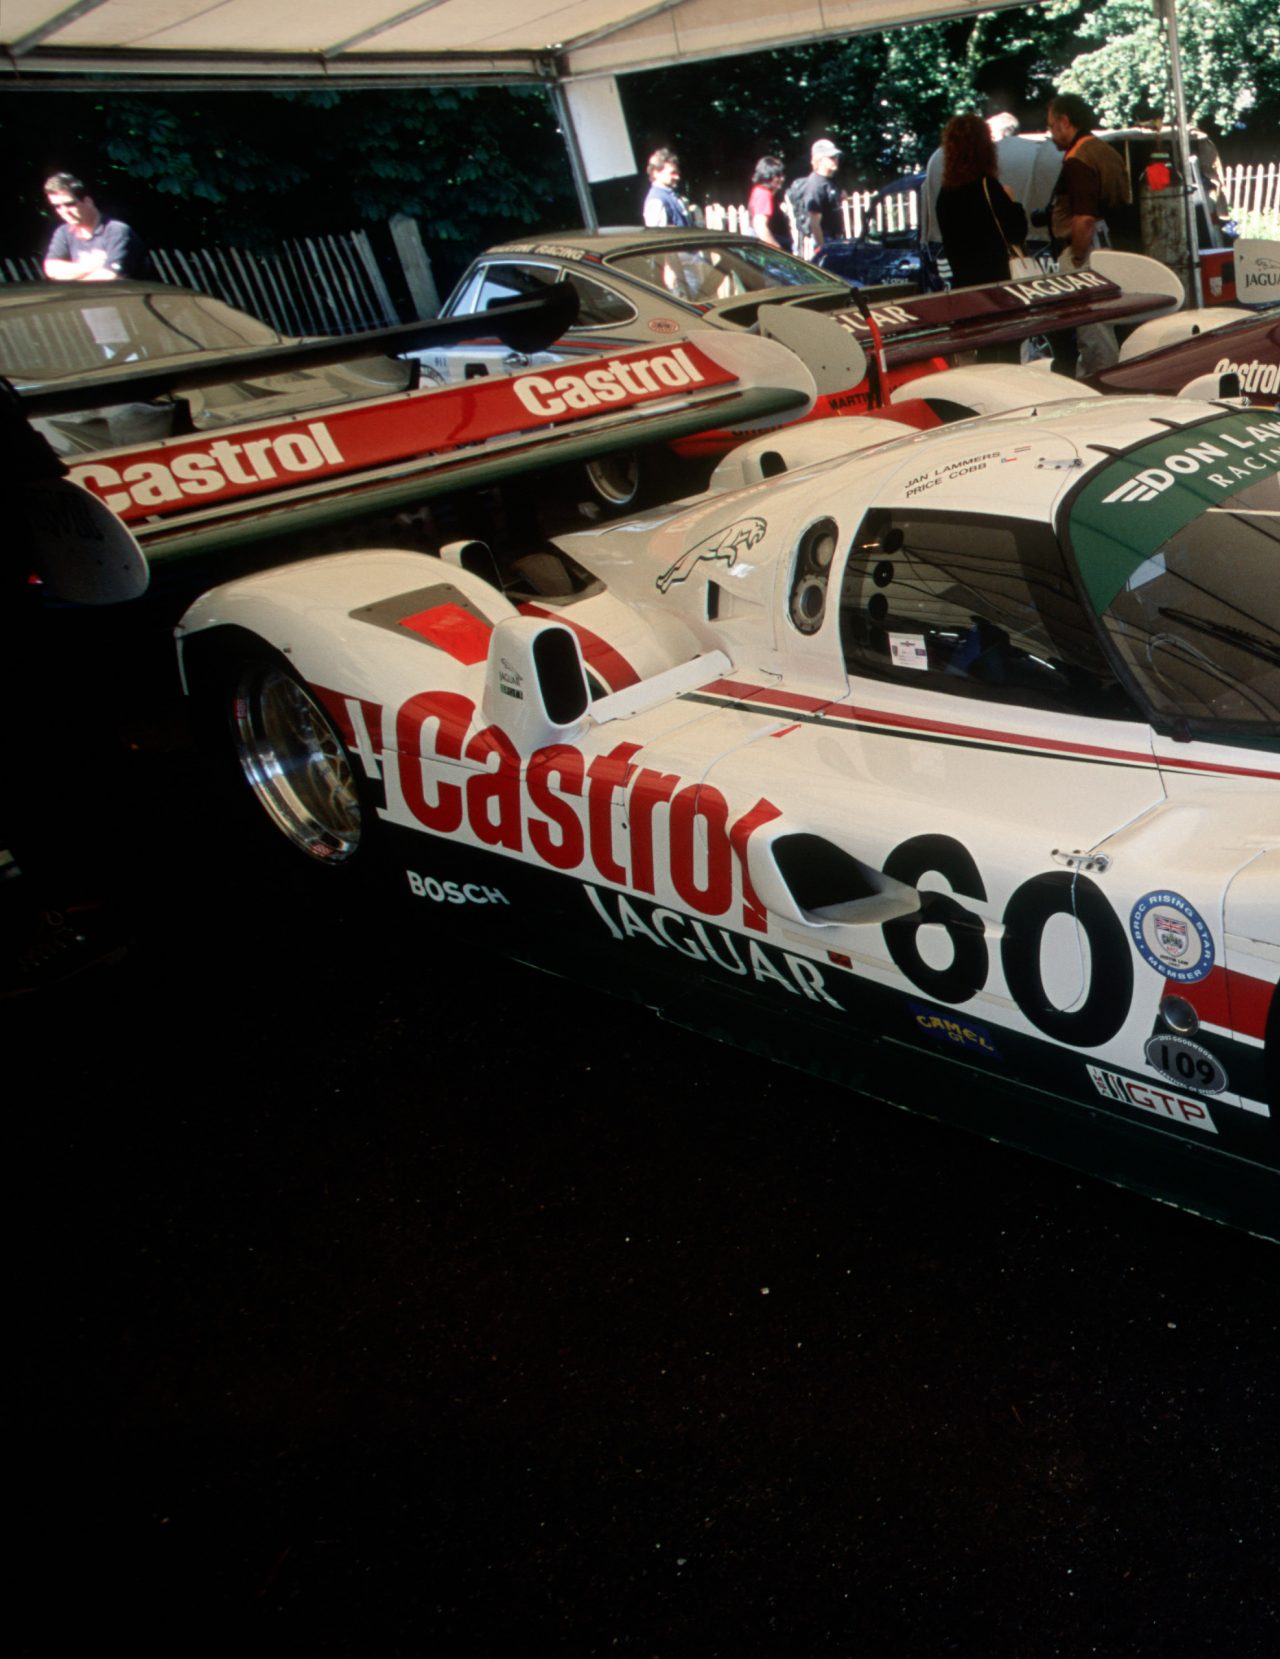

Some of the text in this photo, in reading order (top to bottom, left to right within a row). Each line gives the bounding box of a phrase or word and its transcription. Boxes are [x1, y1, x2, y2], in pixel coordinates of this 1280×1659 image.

[1003, 270, 1109, 305] JAGUAR
[832, 305, 919, 334] UAR
[68, 347, 704, 514] Castrol Castrol
[904, 451, 1001, 489] JAN LAMMERS
[906, 462, 987, 499] PRICE COBB
[1134, 441, 1229, 493] DON
[406, 870, 511, 905] BOSCH
[881, 833, 1135, 1048] 60
[1133, 895, 1212, 960] BRDC RISING STAR
[582, 884, 848, 1012] JAGUAR
[1148, 956, 1202, 980] MEMBER
[915, 1015, 995, 1052] CAMEL
[1161, 1044, 1216, 1085] 109
[1125, 1082, 1206, 1121] GTP
